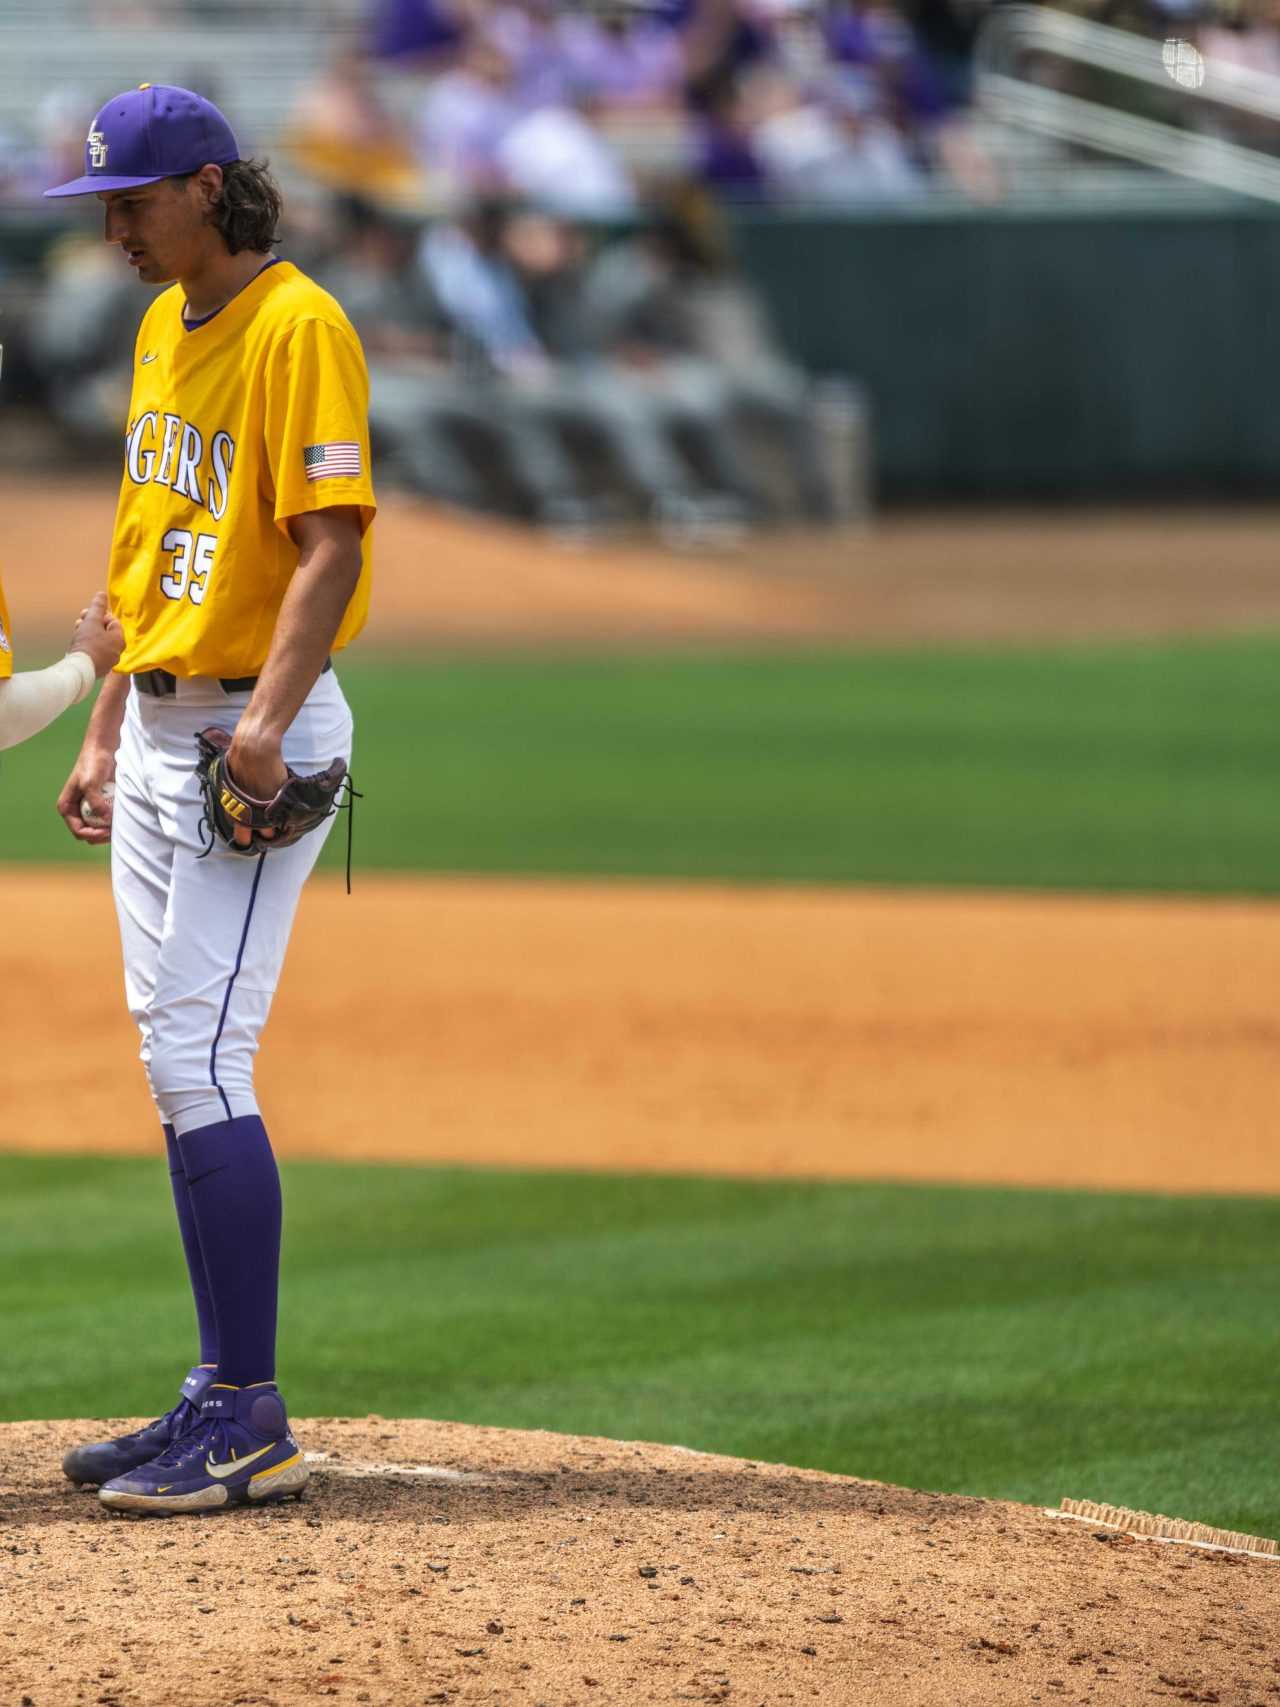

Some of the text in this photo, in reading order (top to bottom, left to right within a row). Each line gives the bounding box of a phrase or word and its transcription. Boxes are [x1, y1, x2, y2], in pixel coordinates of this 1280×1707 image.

[87, 119, 108, 167] LSU
[126, 410, 235, 521] GERS
[160, 528, 218, 605] 35
